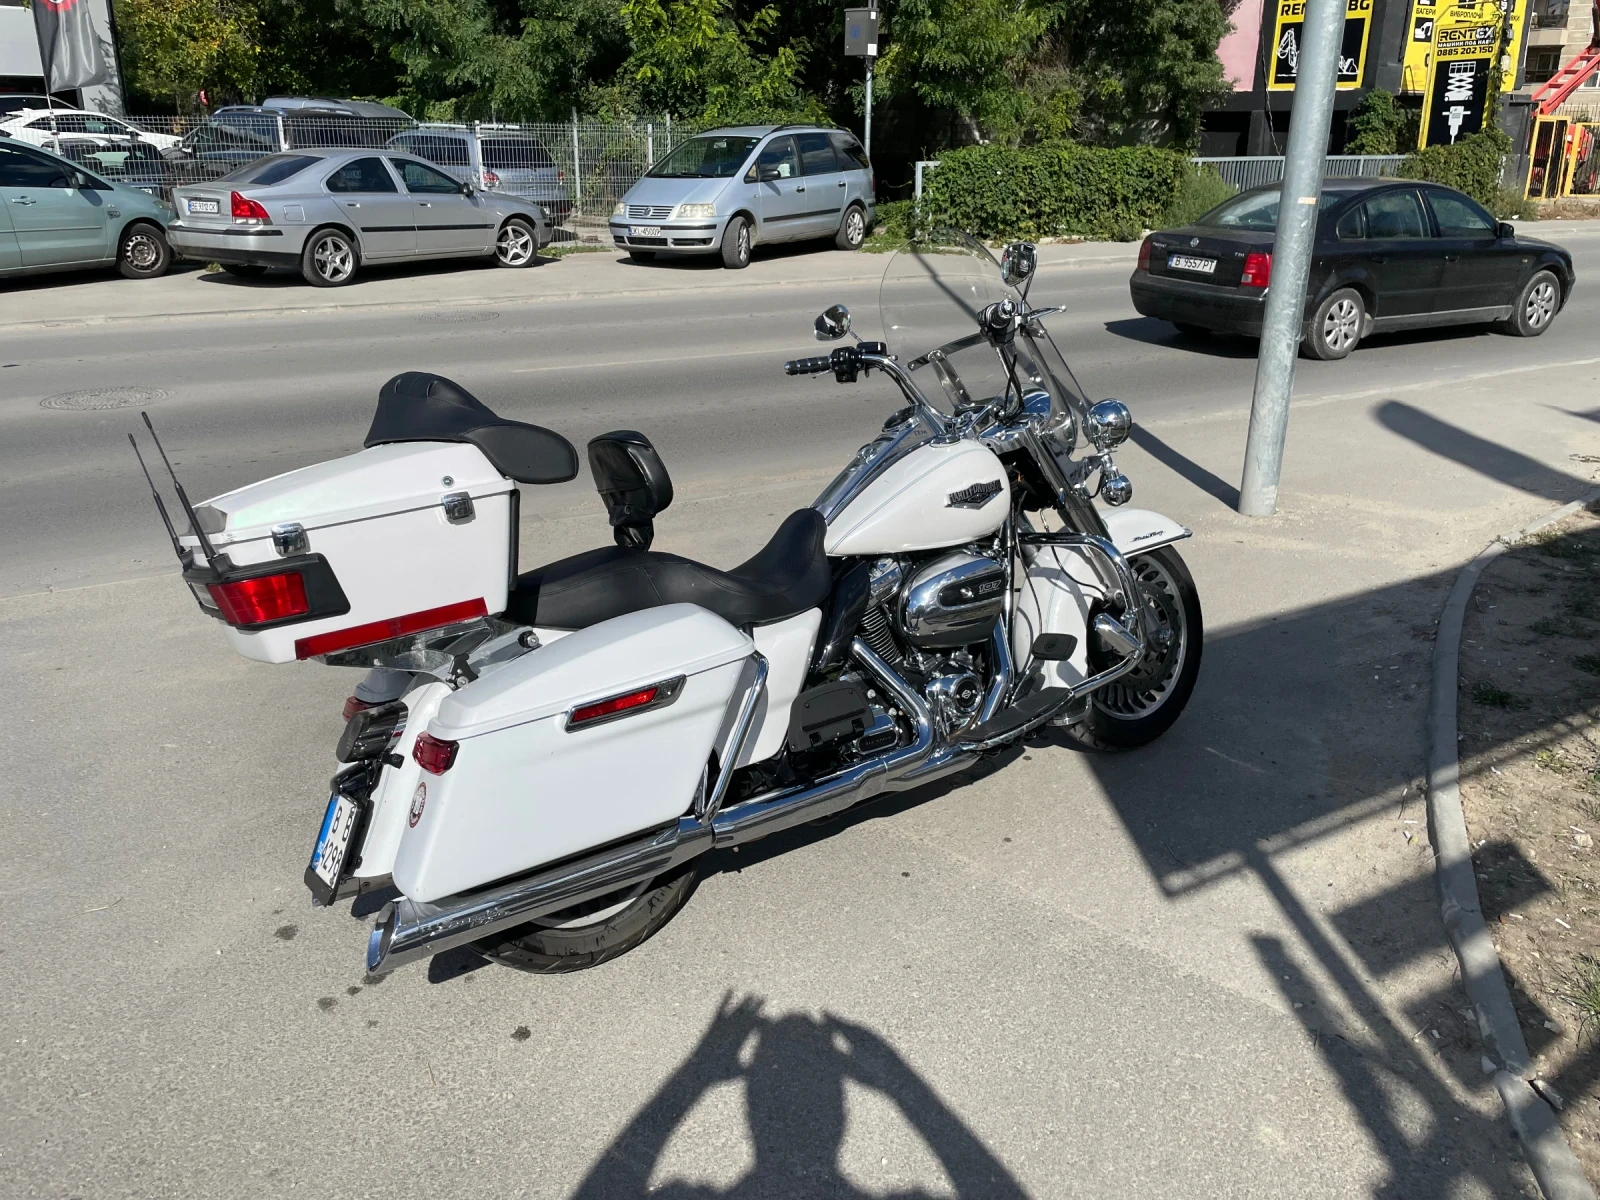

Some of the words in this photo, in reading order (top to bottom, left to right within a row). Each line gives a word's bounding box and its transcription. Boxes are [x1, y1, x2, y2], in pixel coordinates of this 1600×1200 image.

[1440, 27, 1495, 41] RENTEX
[1437, 48, 1459, 57] 0885
[1460, 46, 1477, 55] 202
[1479, 45, 1494, 53] 150
[978, 579, 1002, 595] 107
[320, 838, 343, 877] 4298
